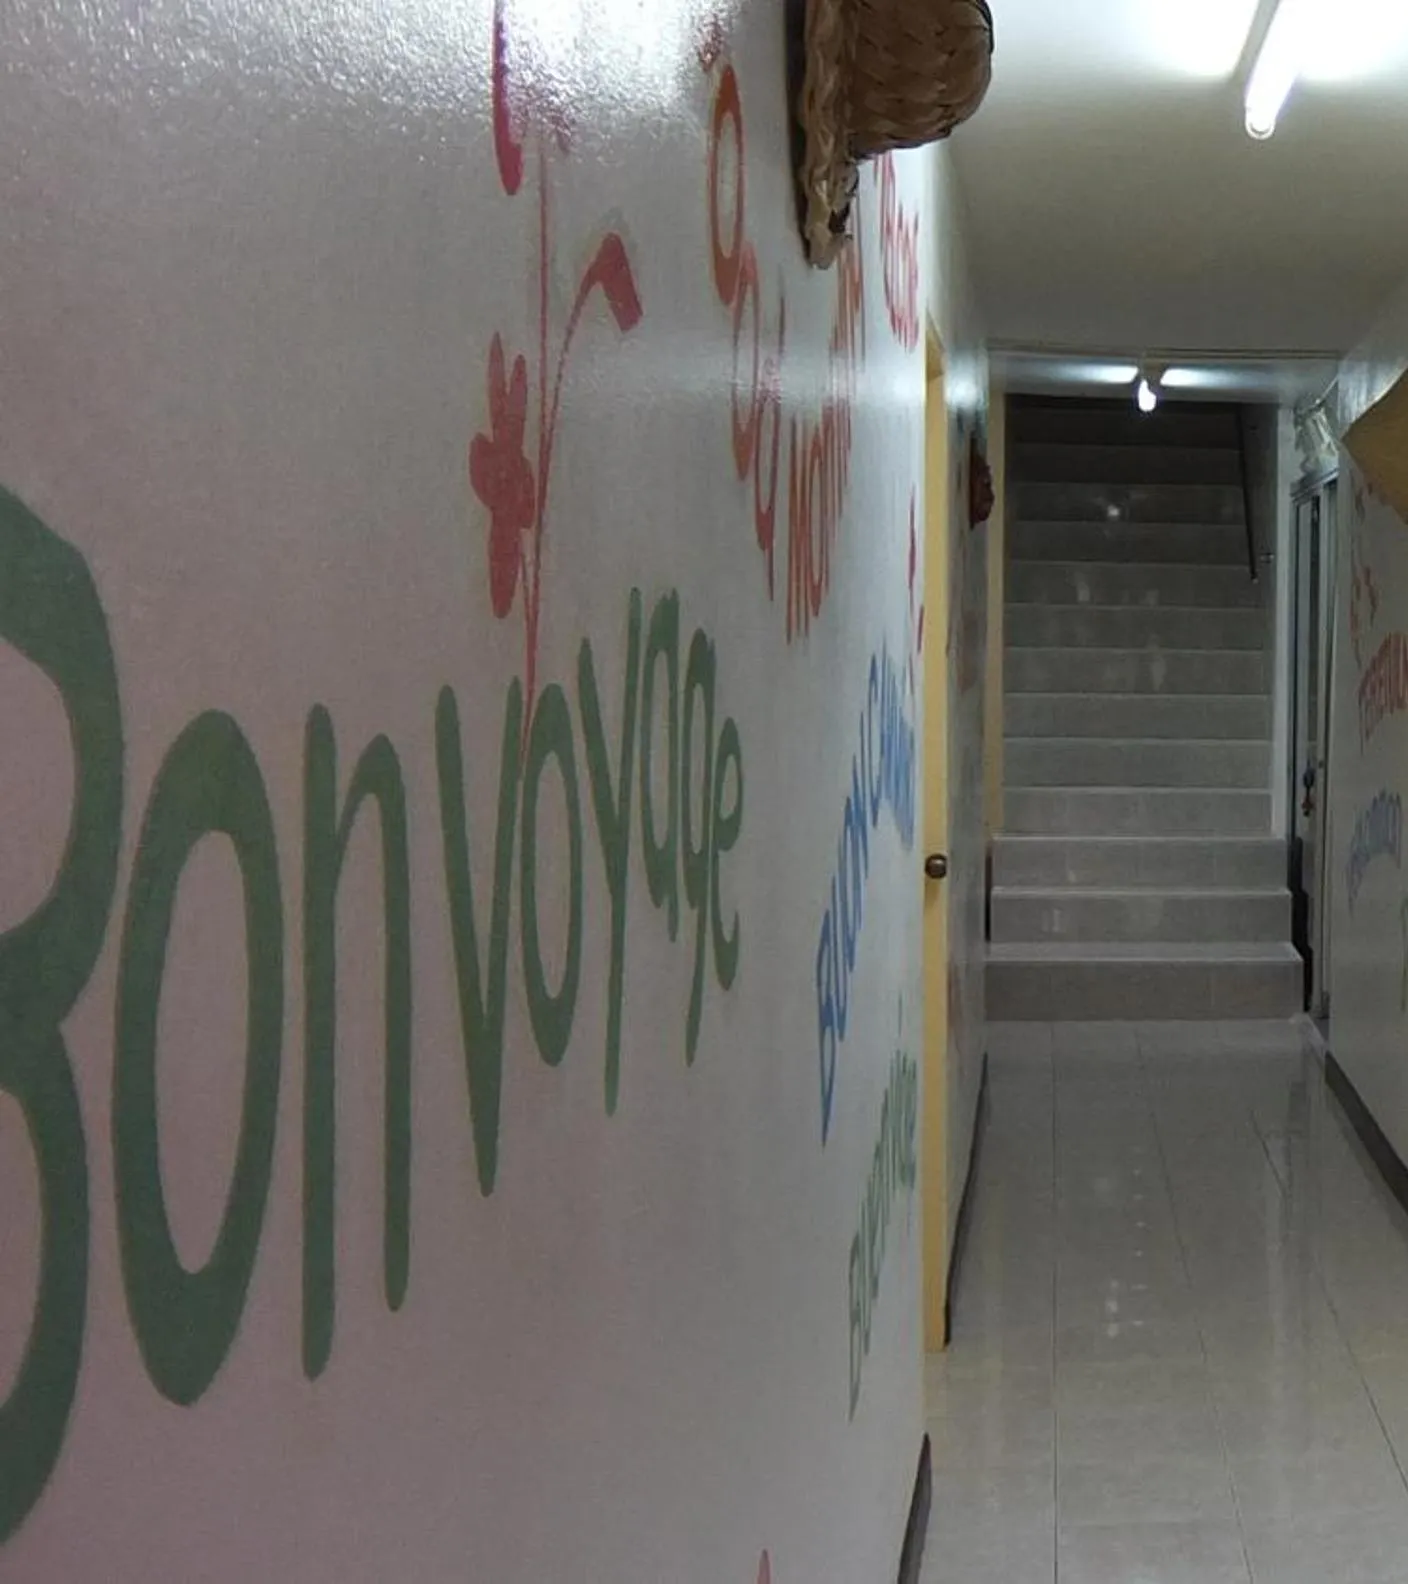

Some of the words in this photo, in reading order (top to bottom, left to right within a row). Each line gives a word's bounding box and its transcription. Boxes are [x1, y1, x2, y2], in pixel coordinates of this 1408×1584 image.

[697, 12, 786, 603] ood
[0, 482, 412, 1556] Bon
[434, 586, 743, 1198] voyage
